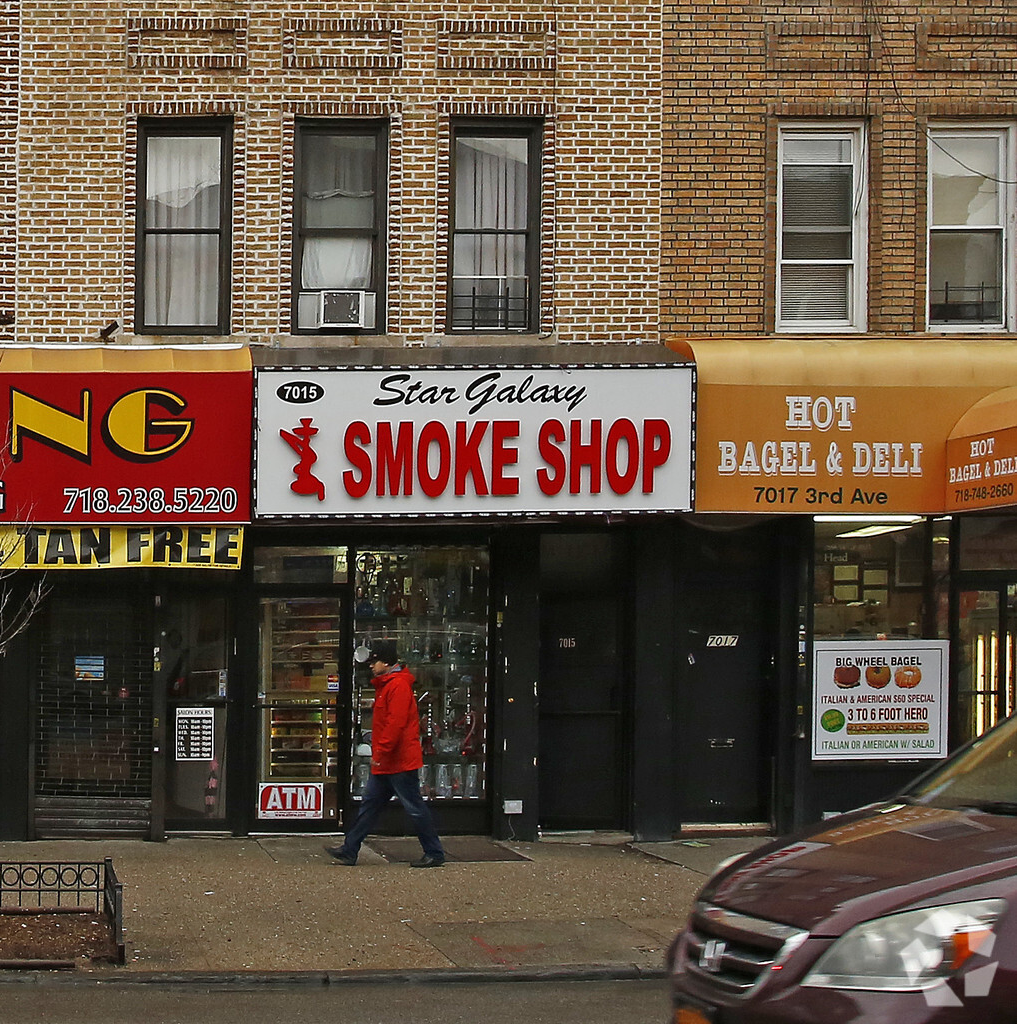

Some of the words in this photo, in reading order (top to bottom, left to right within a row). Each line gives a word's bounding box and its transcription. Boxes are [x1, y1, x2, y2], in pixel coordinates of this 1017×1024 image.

[283, 385, 317, 400] 7015
[373, 374, 461, 406] Star
[465, 372, 589, 414] Galaxy
[785, 395, 856, 431] HOT
[342, 420, 521, 498] SMOKE
[536, 417, 672, 496] SHOP
[970, 438, 995, 458] HOT
[717, 441, 817, 477] BAGEL
[825, 442, 843, 477] &
[852, 442, 924, 478] DELI
[949, 463, 982, 484] BAGEL
[984, 461, 991, 479] &
[63, 487, 238, 513] 718.238.5220
[753, 487, 798, 504] 7017
[805, 486, 843, 504] 3rd
[850, 487, 889, 505] Ave
[955, 483, 1014, 503] 718-748-2660
[17, 528, 113, 564] TAN
[128, 527, 240, 564] FREE
[559, 637, 576, 648] 7015
[707, 635, 738, 647] 7017
[835, 657, 852, 667] BIG
[855, 657, 888, 667] WHEEL
[890, 656, 922, 666] BAGEL
[821, 695, 848, 704] ITALIAN
[849, 695, 855, 704] &
[856, 695, 892, 704] AMERICAN
[907, 694, 935, 703] SPECIAL
[848, 708, 854, 721] 3
[856, 708, 868, 721] TO
[870, 708, 876, 721] 6
[878, 708, 902, 721] FOOT
[904, 707, 928, 720] HERO
[822, 740, 849, 750] ITALIAN
[851, 740, 861, 749] OR
[862, 740, 899, 749] AMERICAN
[900, 740, 910, 749] W/
[912, 739, 935, 749] SALAD
[266, 787, 316, 810] ATM
